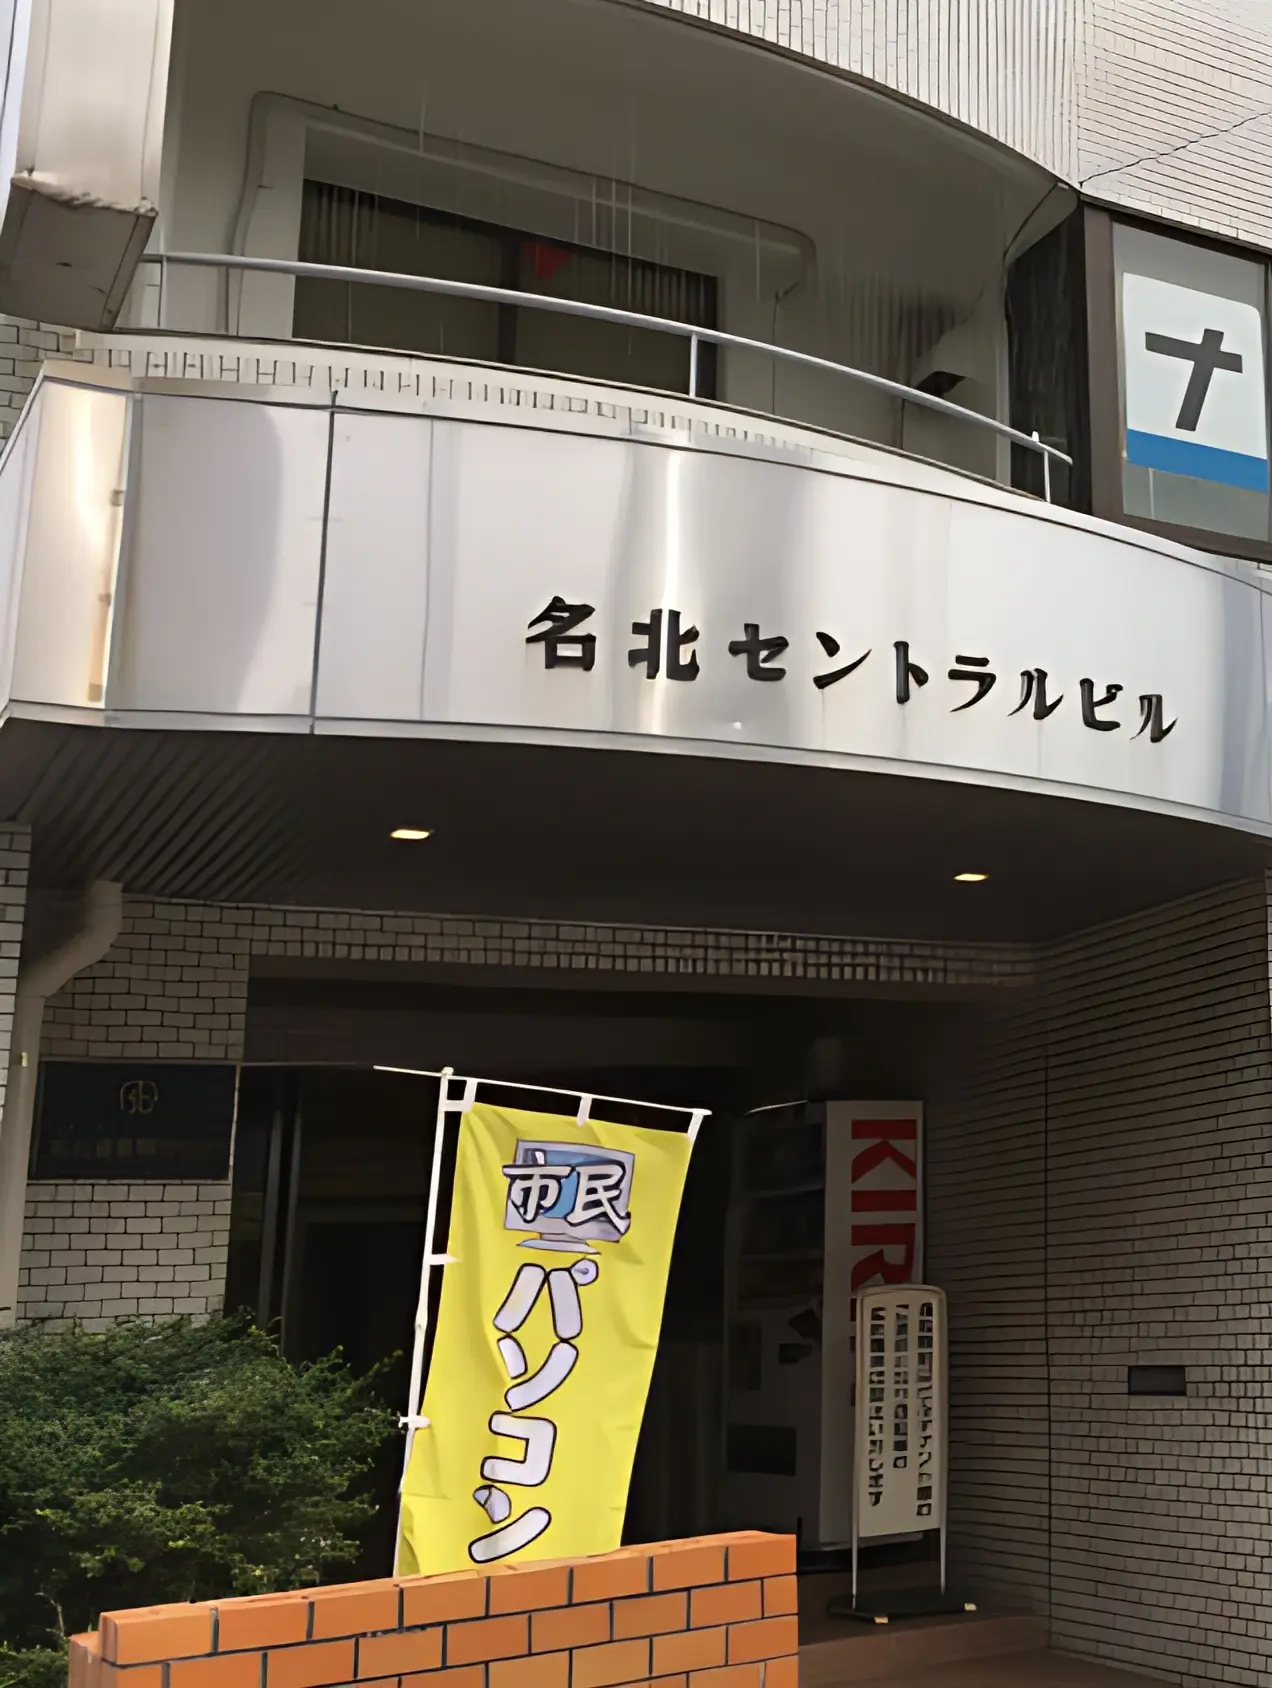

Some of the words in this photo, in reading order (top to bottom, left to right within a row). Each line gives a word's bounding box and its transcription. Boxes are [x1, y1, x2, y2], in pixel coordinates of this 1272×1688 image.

[525, 595, 1178, 744] 名北セントラルビル
[501, 1147, 631, 1234] 市民
[467, 1257, 599, 1564] パソコン
